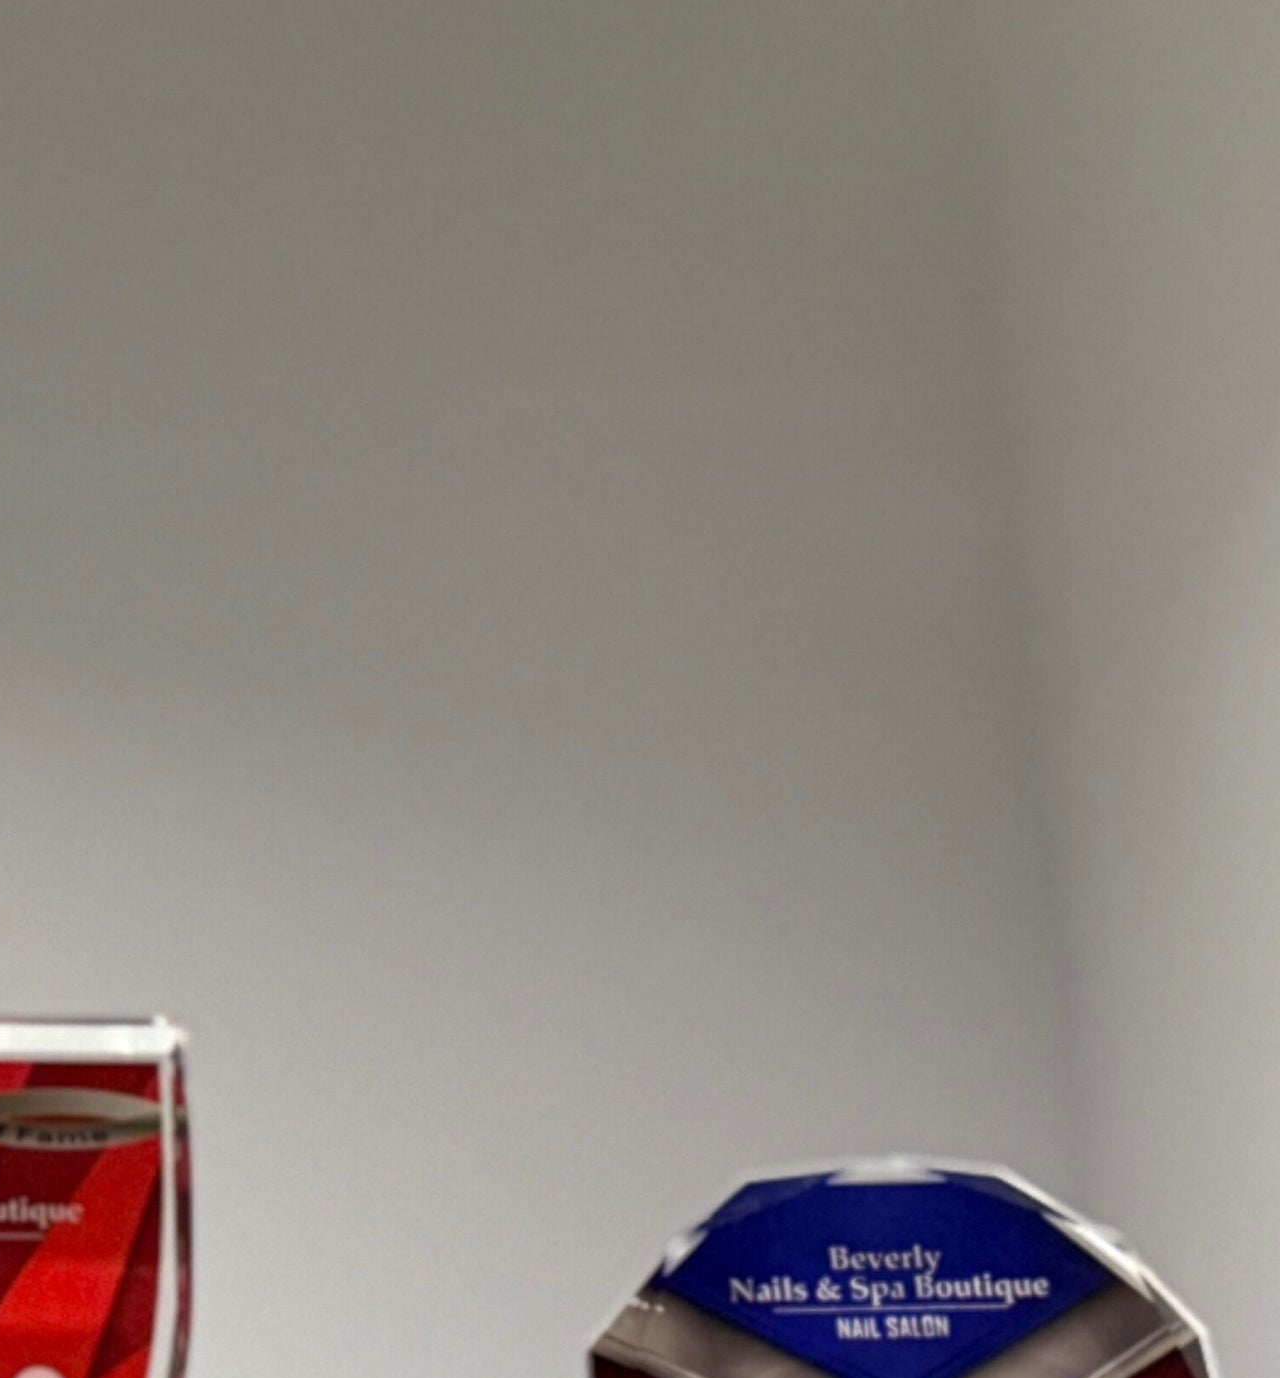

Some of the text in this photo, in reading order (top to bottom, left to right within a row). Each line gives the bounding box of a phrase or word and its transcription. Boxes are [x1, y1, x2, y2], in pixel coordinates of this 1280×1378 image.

[828, 1244, 941, 1274] Beverly
[728, 1273, 1051, 1307] Nails & Spa Boutique
[836, 1314, 950, 1339] NAIL SALON
